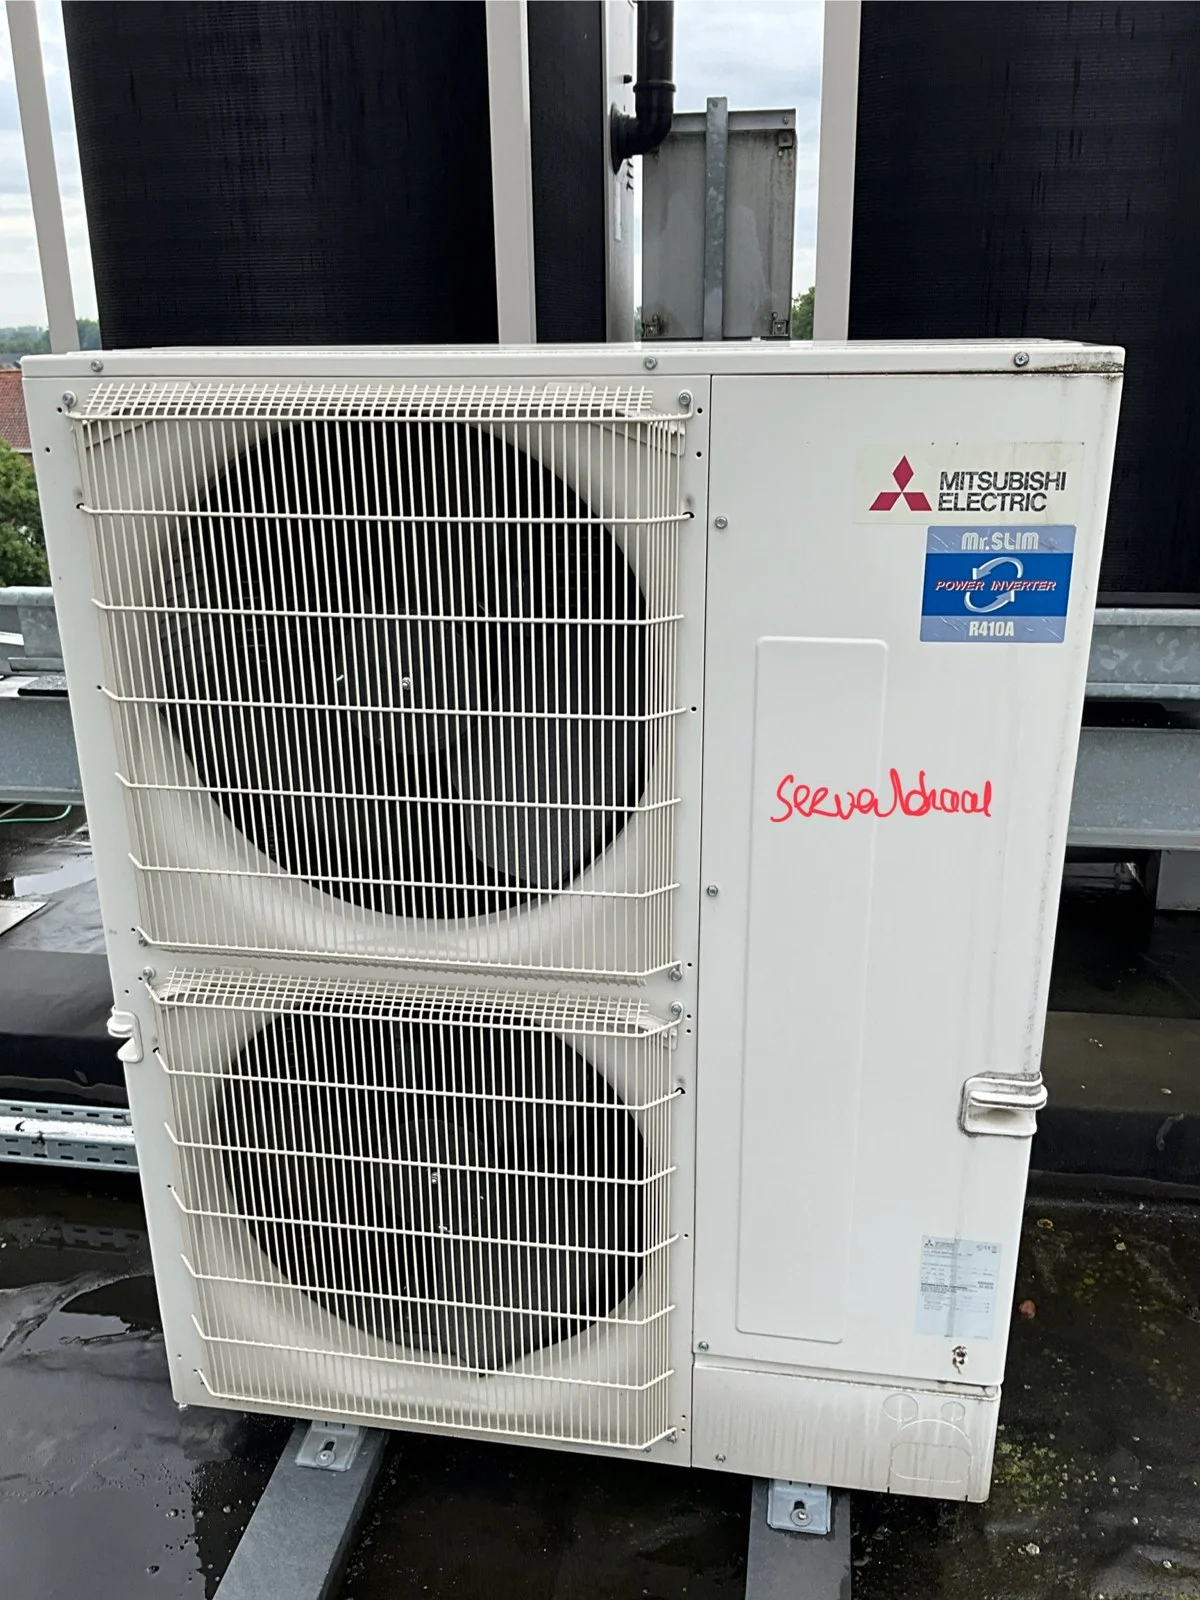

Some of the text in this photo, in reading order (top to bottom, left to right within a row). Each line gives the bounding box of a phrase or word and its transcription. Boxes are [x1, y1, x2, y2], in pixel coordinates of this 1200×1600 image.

[939, 471, 1066, 491] MITSUBISHI
[938, 492, 1047, 512] ELECTRIC
[935, 580, 1057, 592] POWER INVERTER
[968, 621, 1015, 637] R410A
